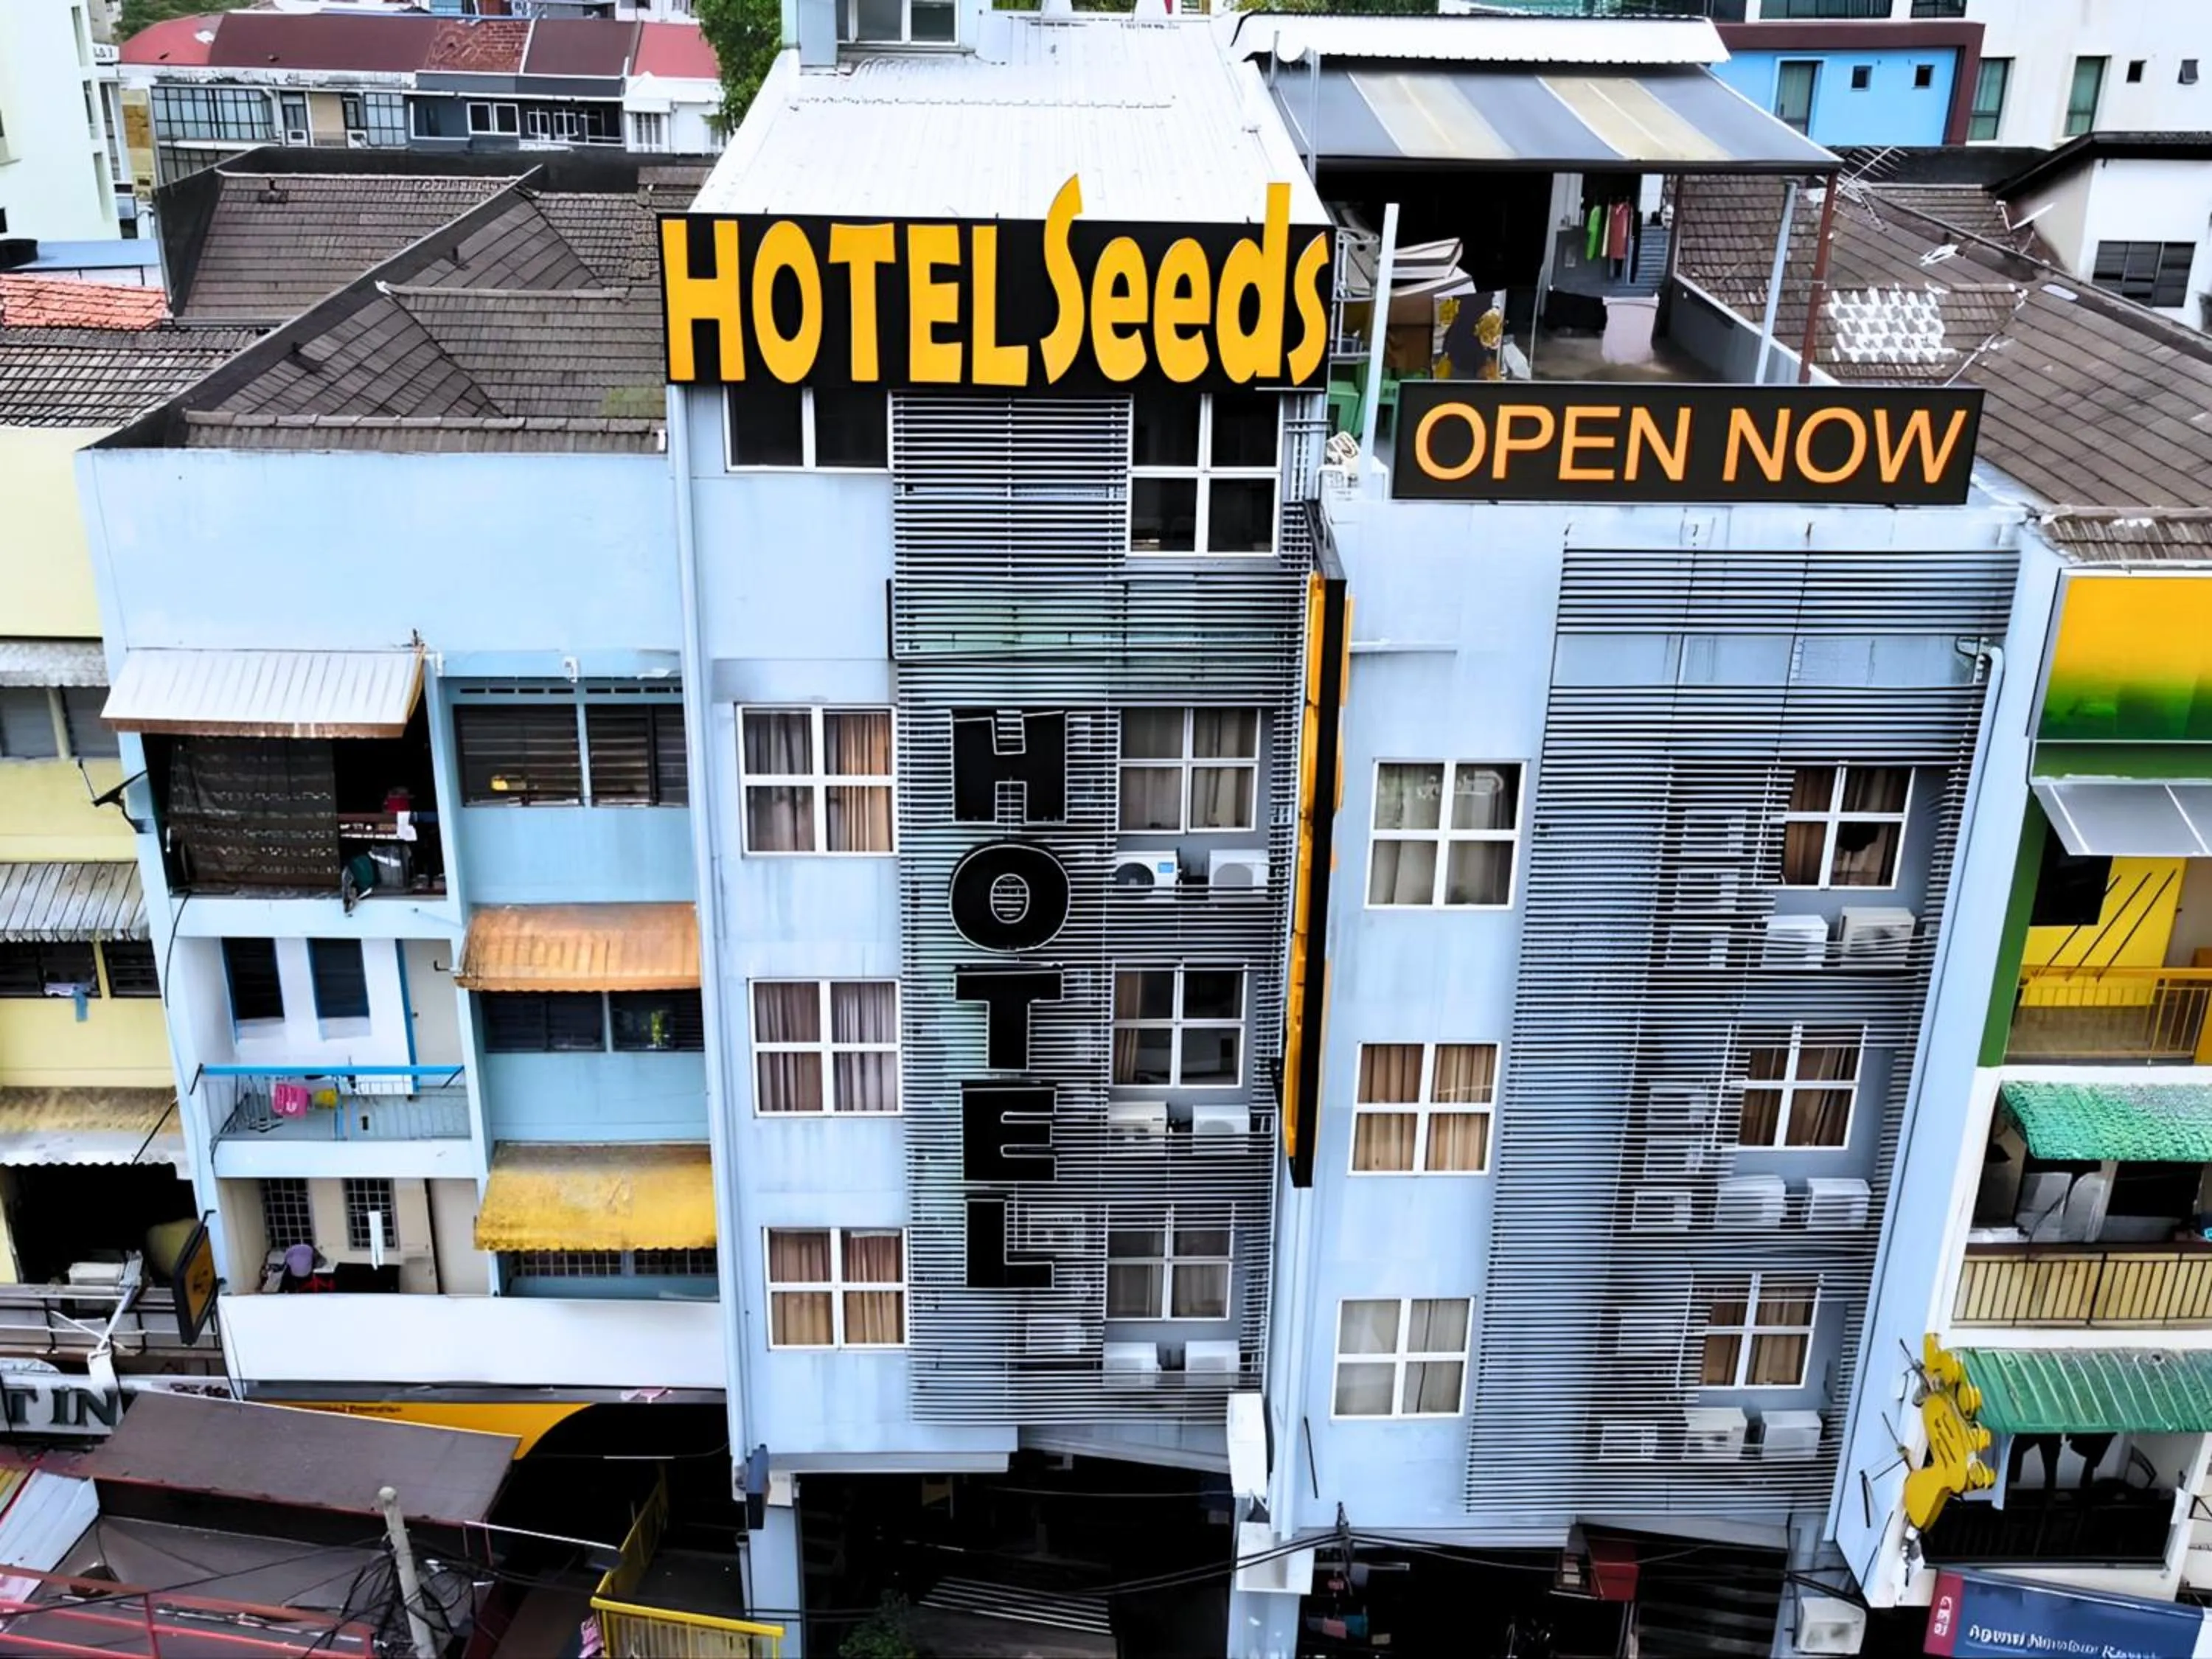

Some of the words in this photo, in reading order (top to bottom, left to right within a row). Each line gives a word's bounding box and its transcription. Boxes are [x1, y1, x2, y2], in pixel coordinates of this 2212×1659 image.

[662, 220, 1028, 386] HOTEL
[1041, 175, 1328, 385] Seeds
[1416, 403, 1691, 480] OPEN
[1723, 408, 1966, 483] NOW
[950, 709, 1071, 1289] HOTEL
